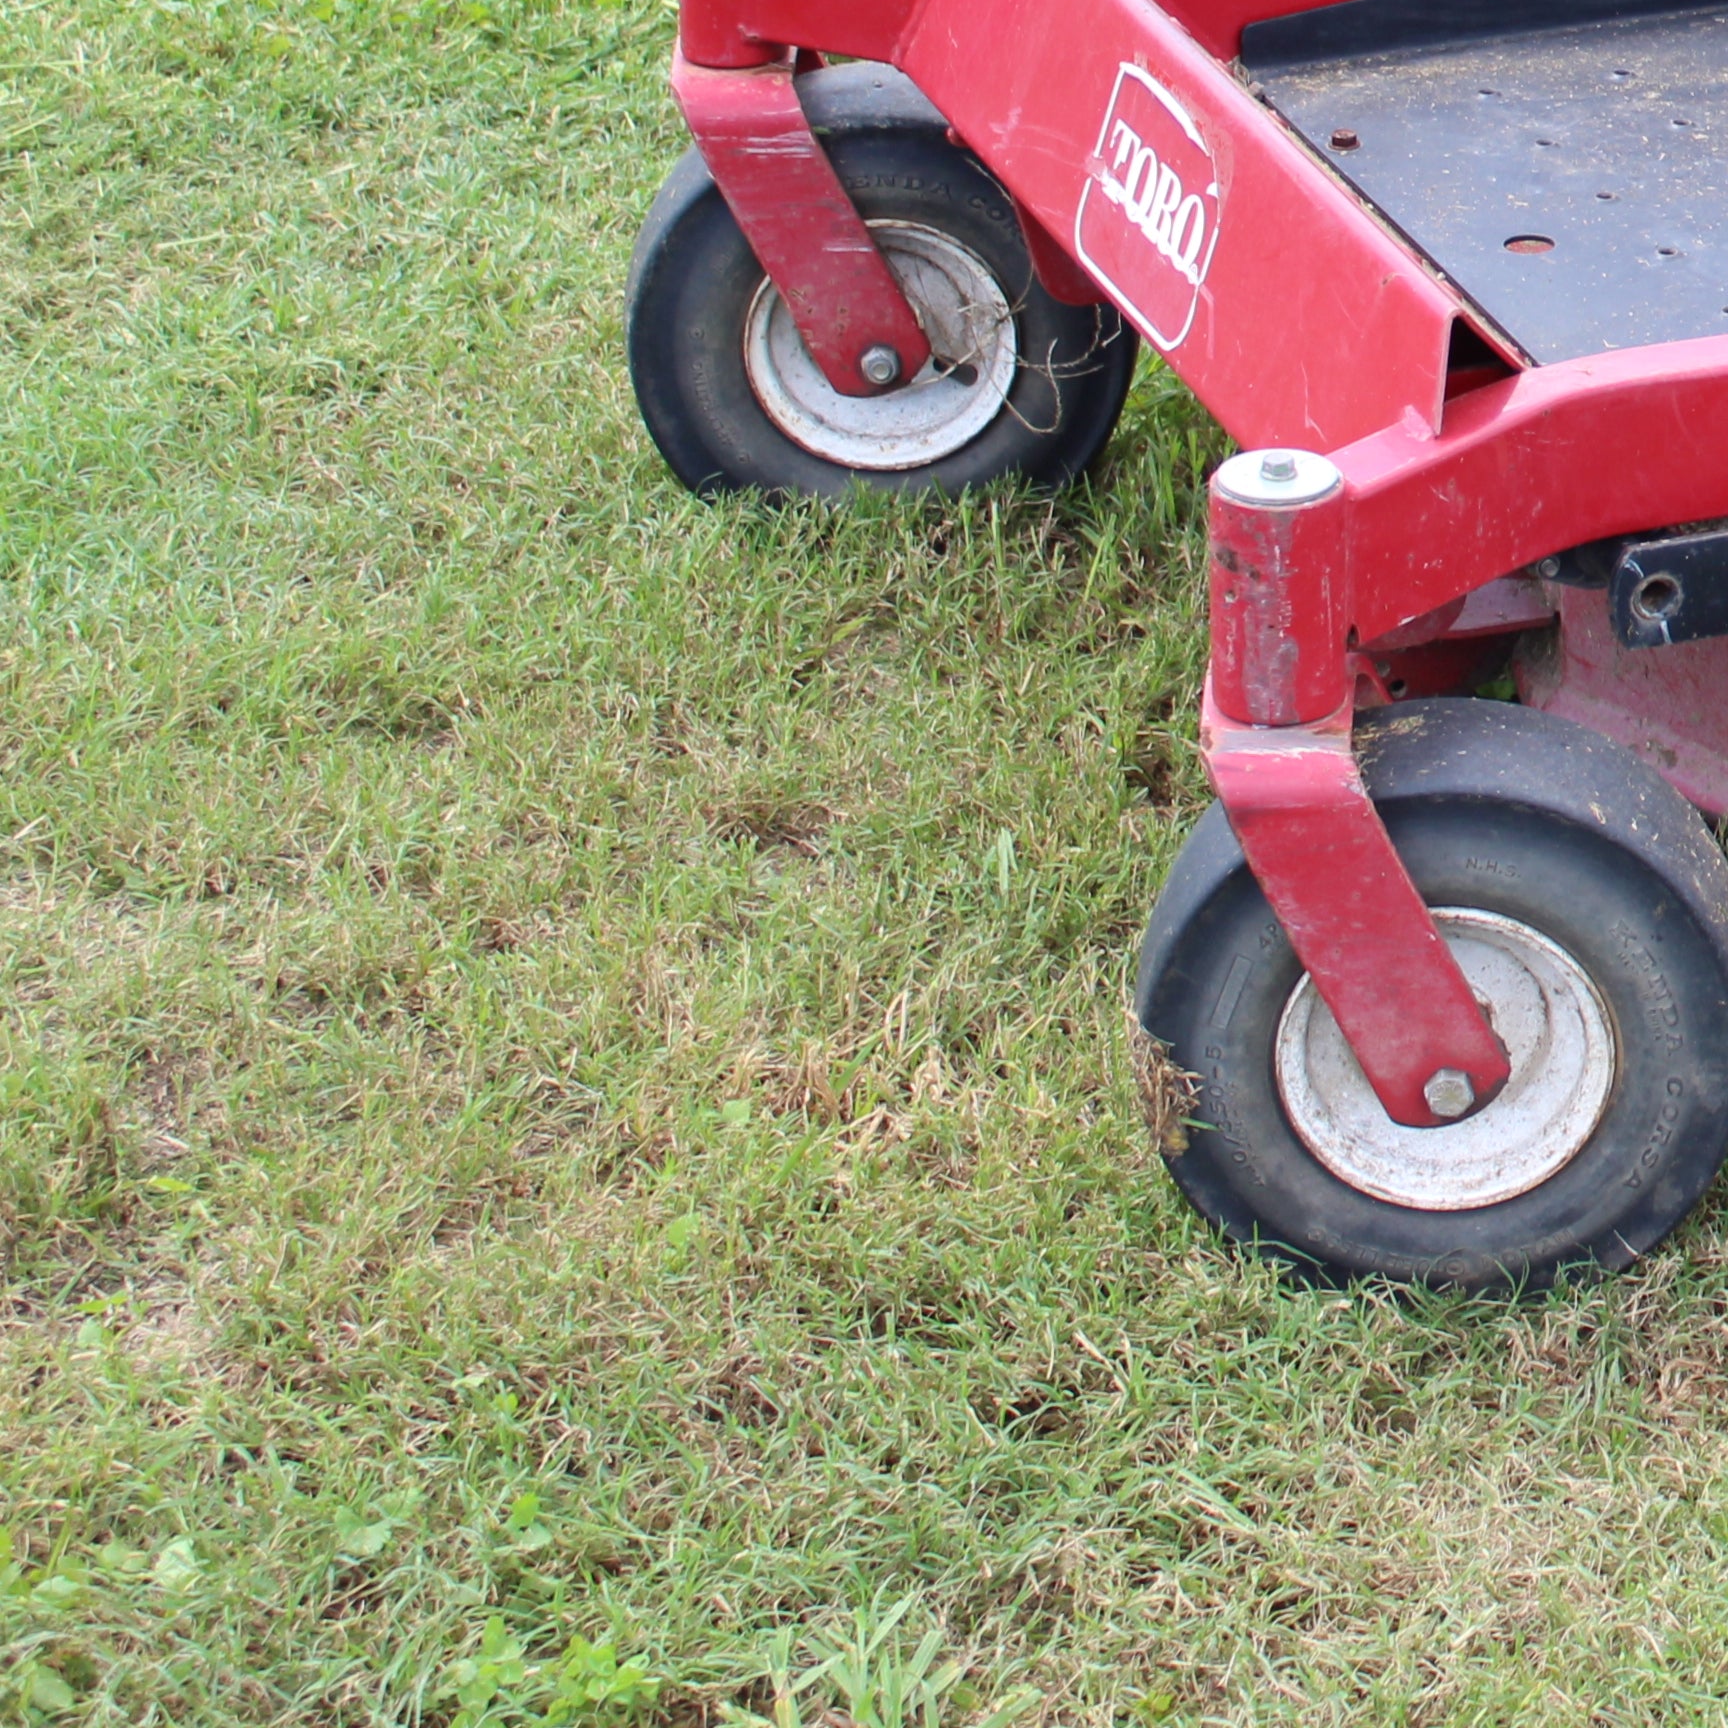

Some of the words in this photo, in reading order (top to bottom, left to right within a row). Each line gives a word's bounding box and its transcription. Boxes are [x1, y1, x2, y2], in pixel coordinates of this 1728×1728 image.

[846, 174, 953, 202] ENDA
[1101, 117, 1206, 277] TORO
[1464, 857, 1522, 879] N.H.S.
[1608, 918, 1684, 1053] KENDA
[1622, 1076, 1685, 1190] CORSA
